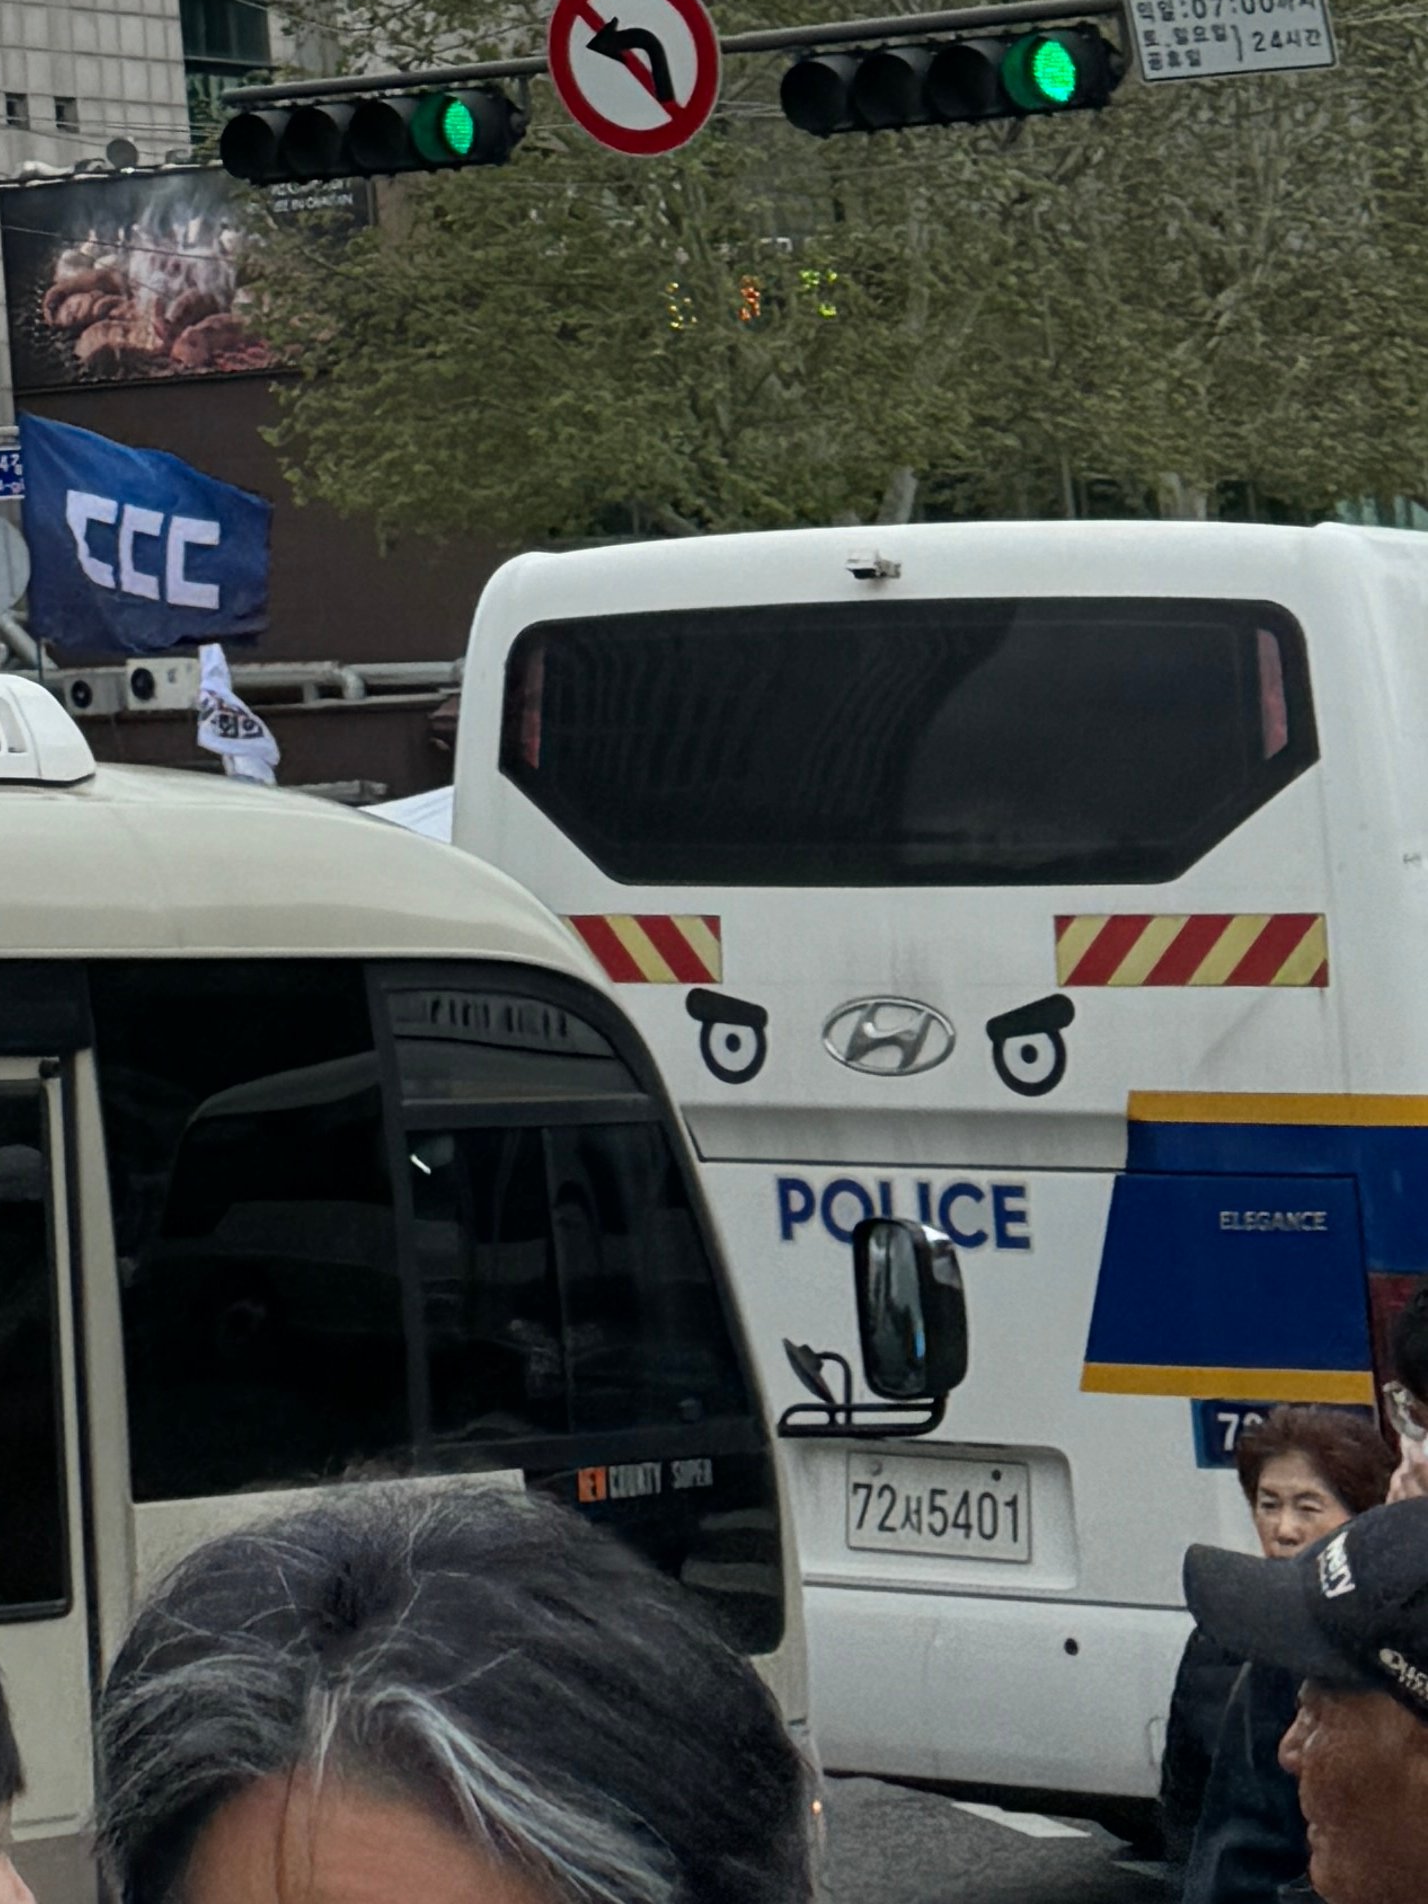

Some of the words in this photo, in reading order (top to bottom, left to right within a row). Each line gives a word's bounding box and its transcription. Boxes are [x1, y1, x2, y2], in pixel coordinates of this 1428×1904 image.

[1252, 28, 1321, 52] 24시간
[66, 489, 220, 609] CCC
[1219, 1211, 1328, 1231] ELEGANCE
[609, 1462, 662, 1499] COUNTY
